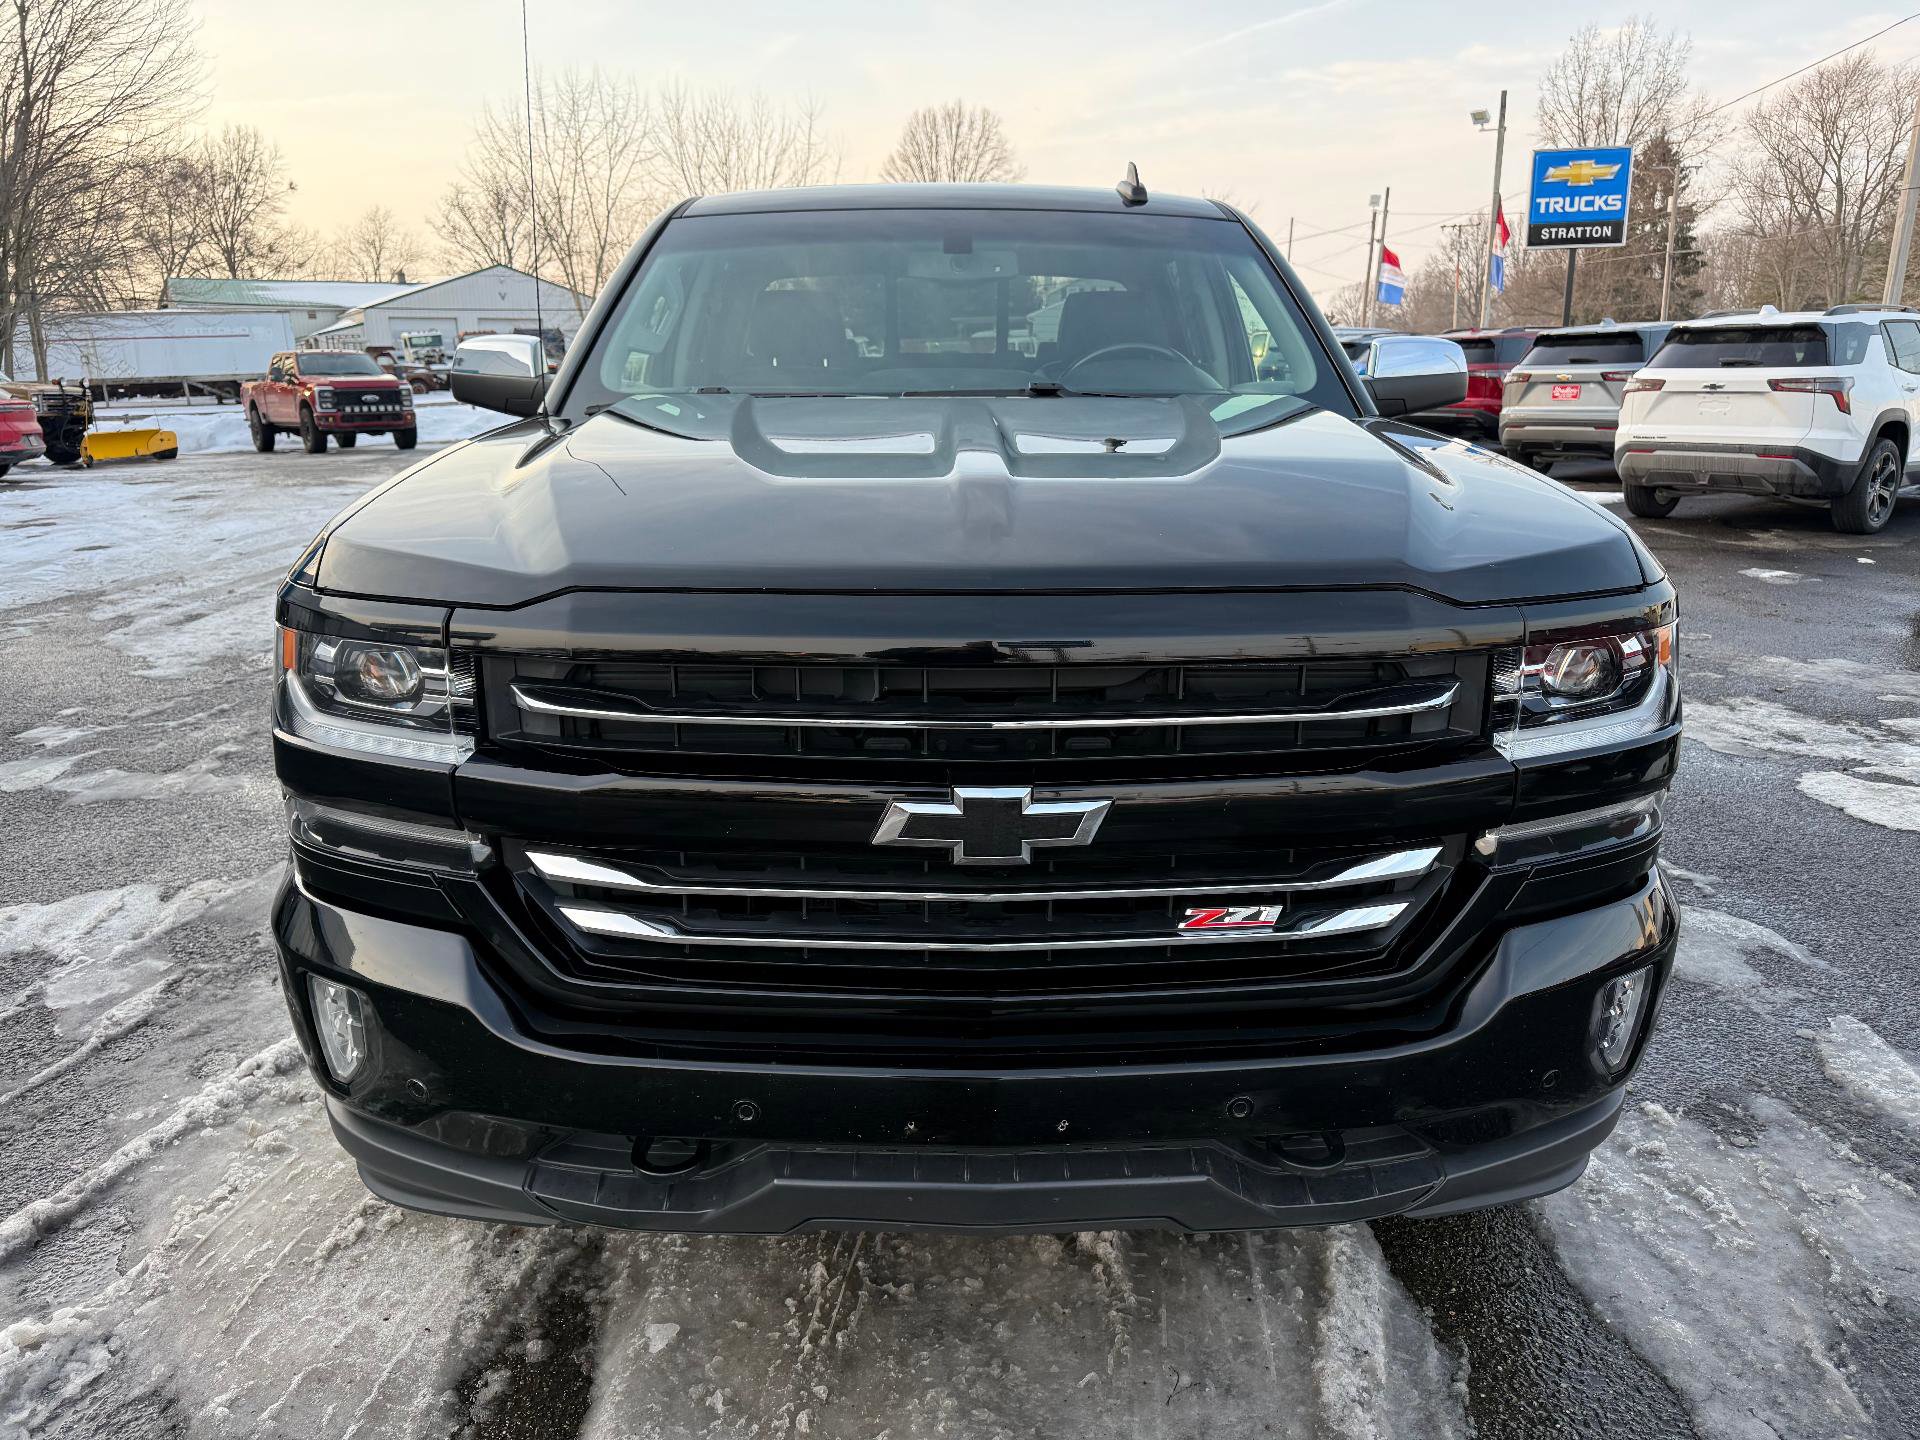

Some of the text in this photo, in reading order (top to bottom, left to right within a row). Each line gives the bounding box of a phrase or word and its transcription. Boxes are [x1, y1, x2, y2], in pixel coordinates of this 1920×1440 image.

[1536, 194, 1622, 214] TRUCKS
[1541, 225, 1612, 240] STRATTON
[1178, 905, 1284, 929] Z71
